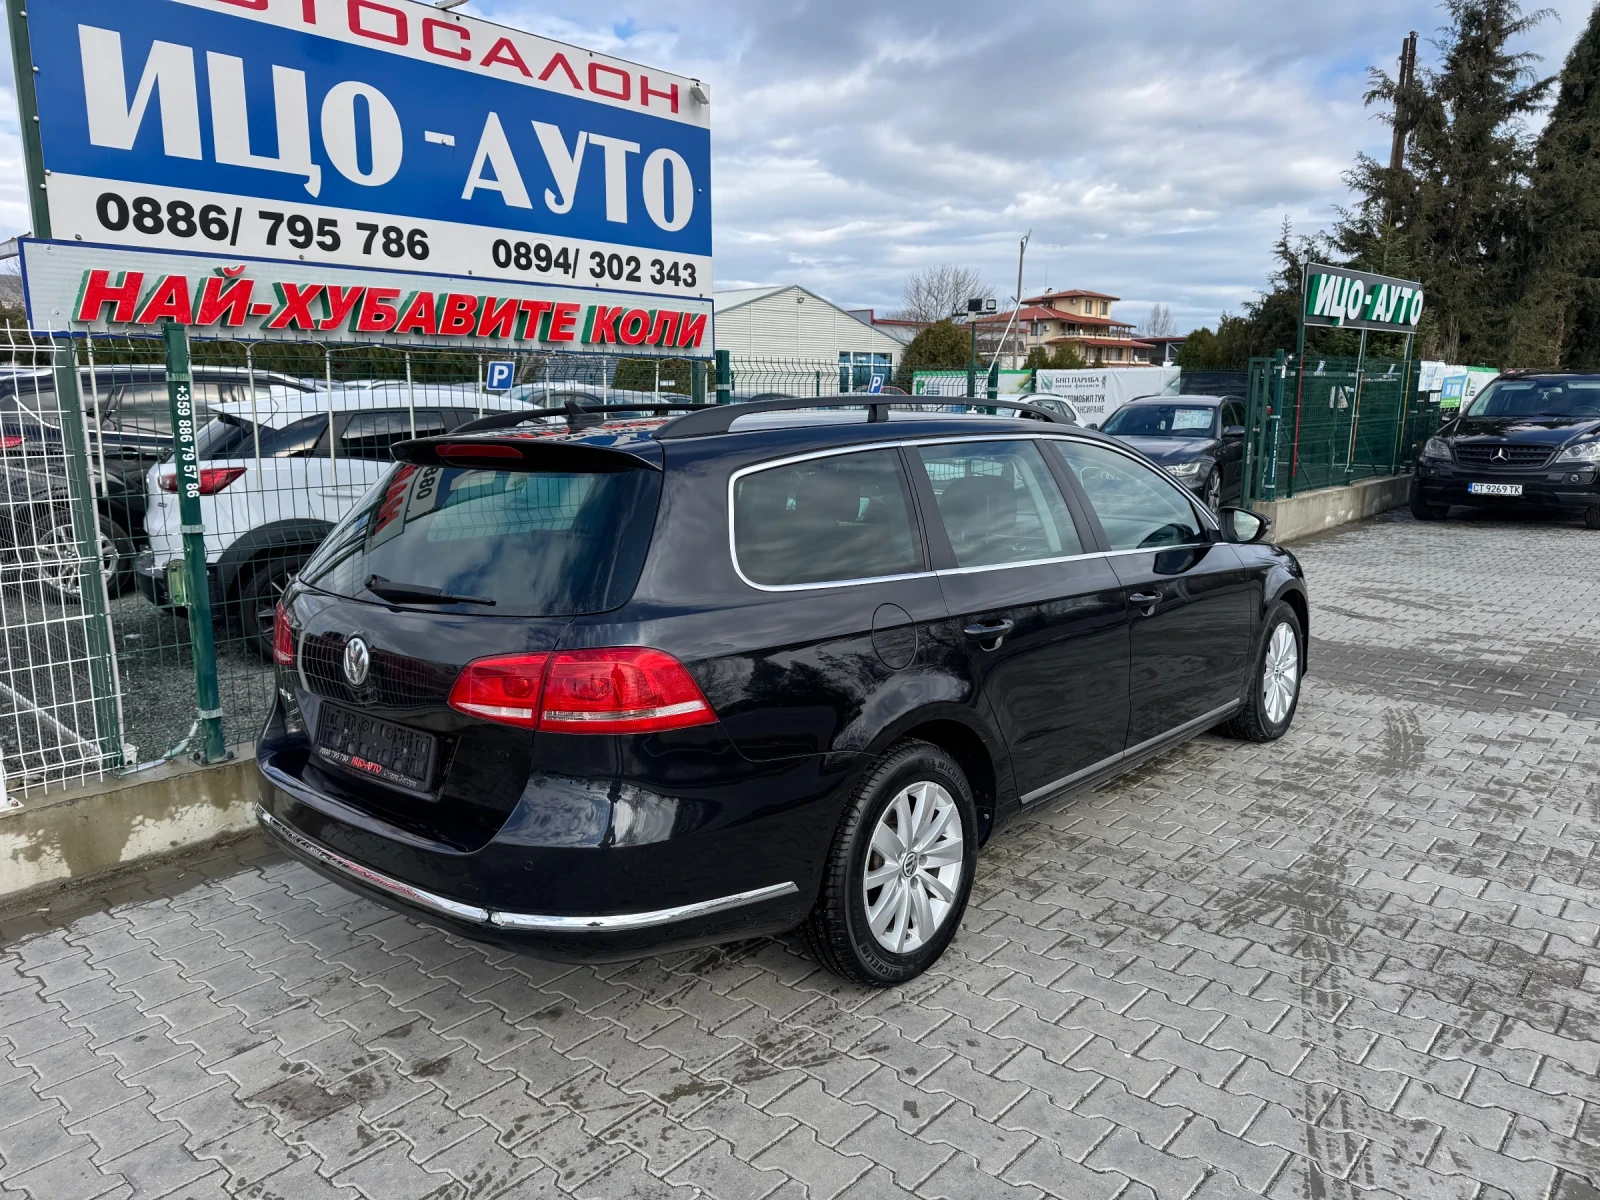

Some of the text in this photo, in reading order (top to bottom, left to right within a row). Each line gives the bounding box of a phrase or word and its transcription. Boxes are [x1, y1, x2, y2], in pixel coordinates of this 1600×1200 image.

[216, 0, 679, 114] ОСАЛОН
[96, 192, 697, 288] 0886/ 795 786 0894/ 302 343
[74, 265, 707, 348] НАЙ-ХУБАВИТЕ КОЛИ
[1314, 273, 1424, 326] ИЦО-АУТО
[492, 365, 509, 387] P
[871, 376, 882, 392] P
[1071, 376, 1100, 384] ПАРИБА
[176, 385, 200, 498] +359 886 79 57 86
[1486, 485, 1508, 494] 9269
[1509, 486, 1521, 495] TK
[860, 944, 902, 978] MICHELIN
